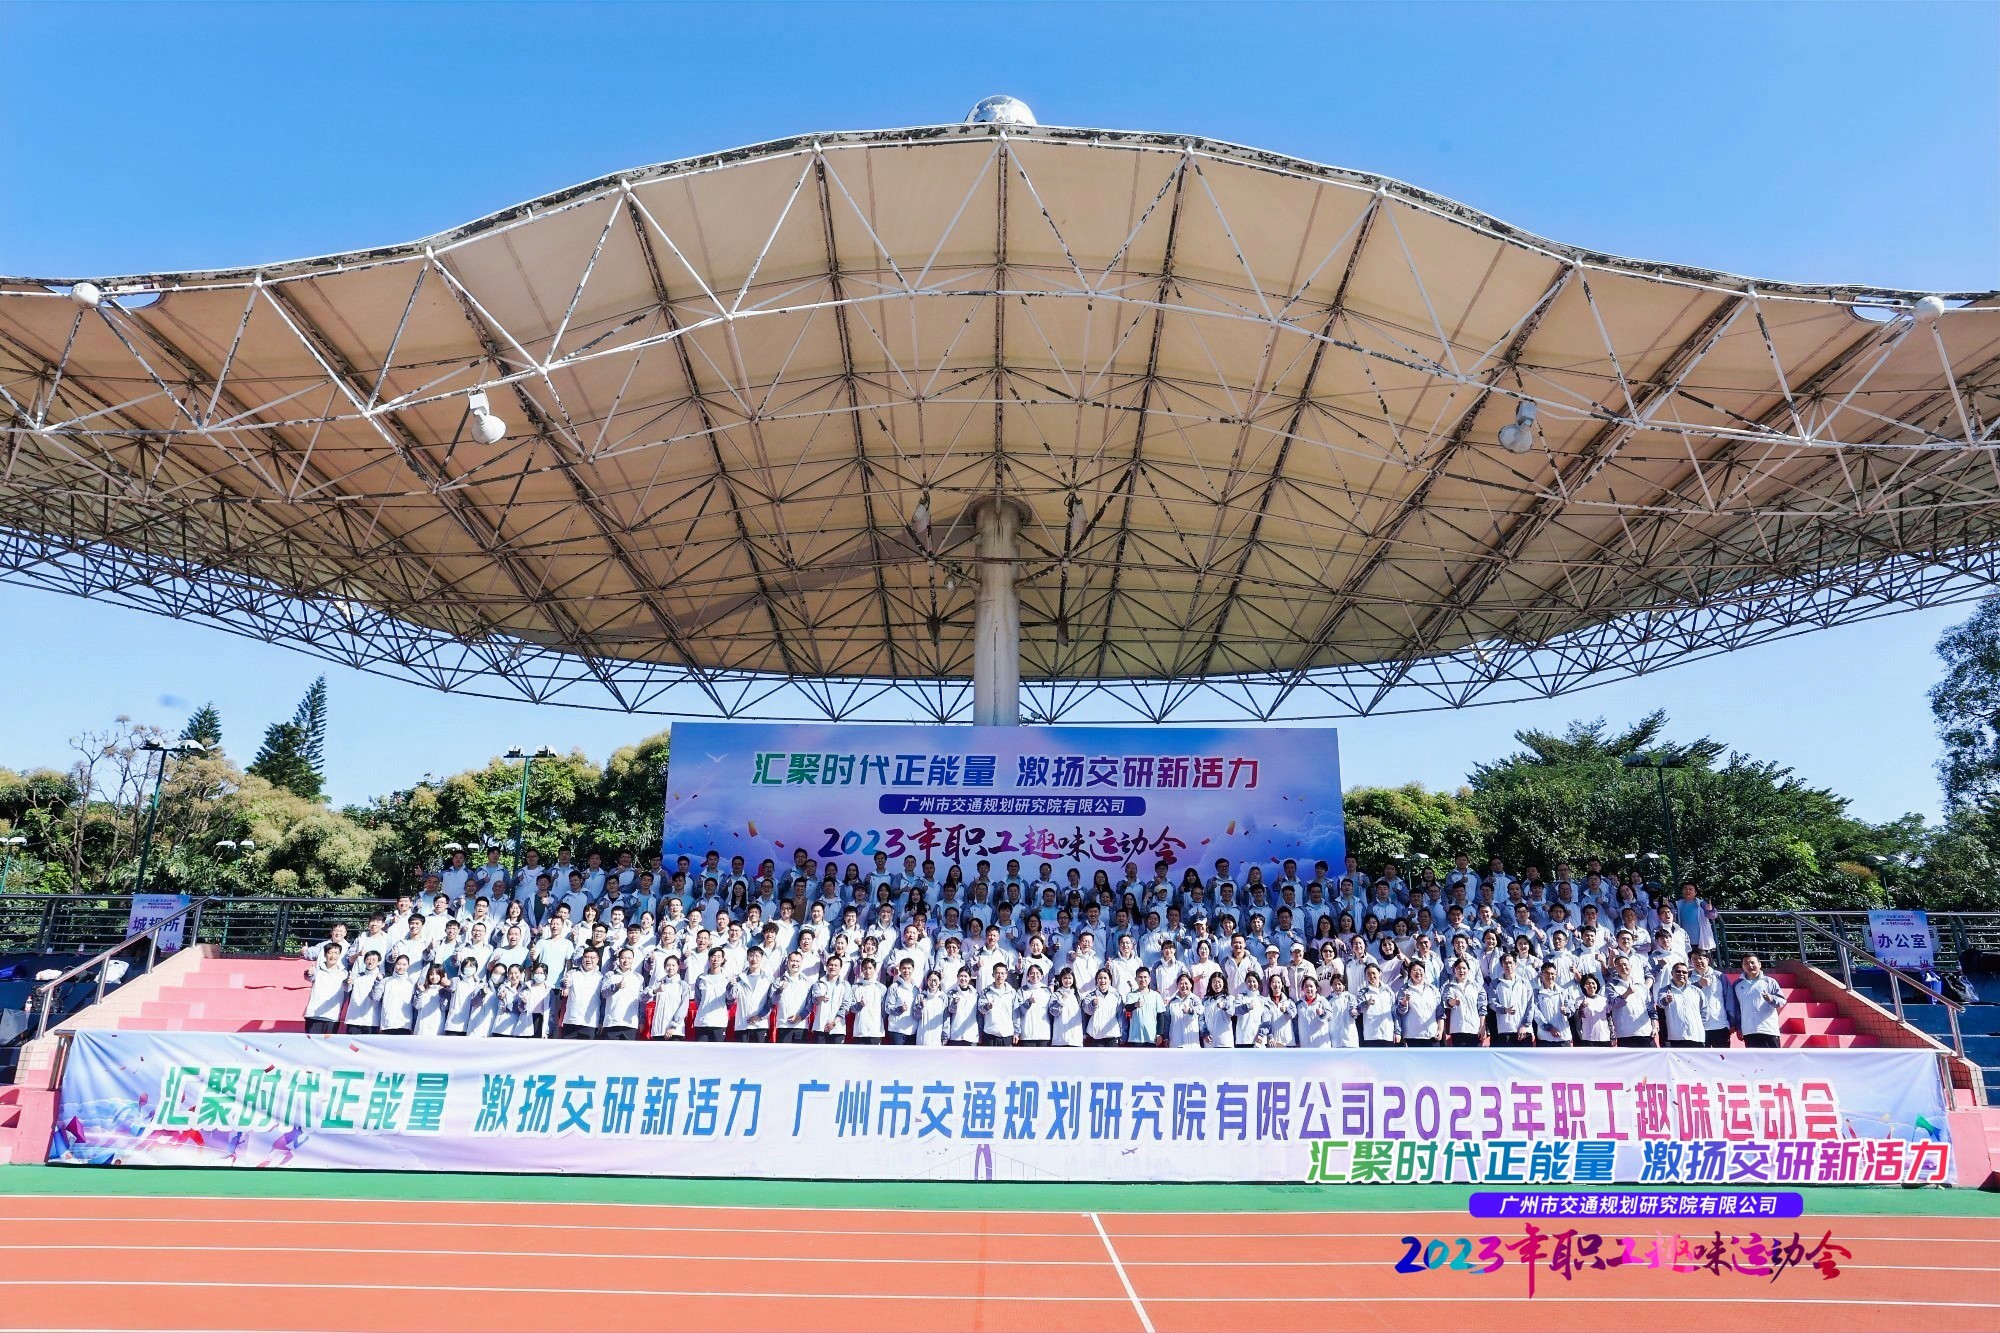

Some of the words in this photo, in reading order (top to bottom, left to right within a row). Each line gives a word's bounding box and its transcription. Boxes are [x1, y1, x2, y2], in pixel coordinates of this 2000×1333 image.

[752, 753, 997, 787] 汇聚时代正能量
[1016, 756, 1259, 789] 激扬交研新活力
[902, 796, 1126, 815] 广州市交通规划研究院有限公司
[817, 818, 1187, 868] 2023年职工趣味运动会
[1877, 933, 1927, 949] 办公室
[155, 1066, 450, 1133] 汇聚时代正能量
[474, 1073, 763, 1137] 激扬交研新活力
[791, 1079, 1839, 1142] 广州市交通规划研究院有限公司2023年职工趣味运动会
